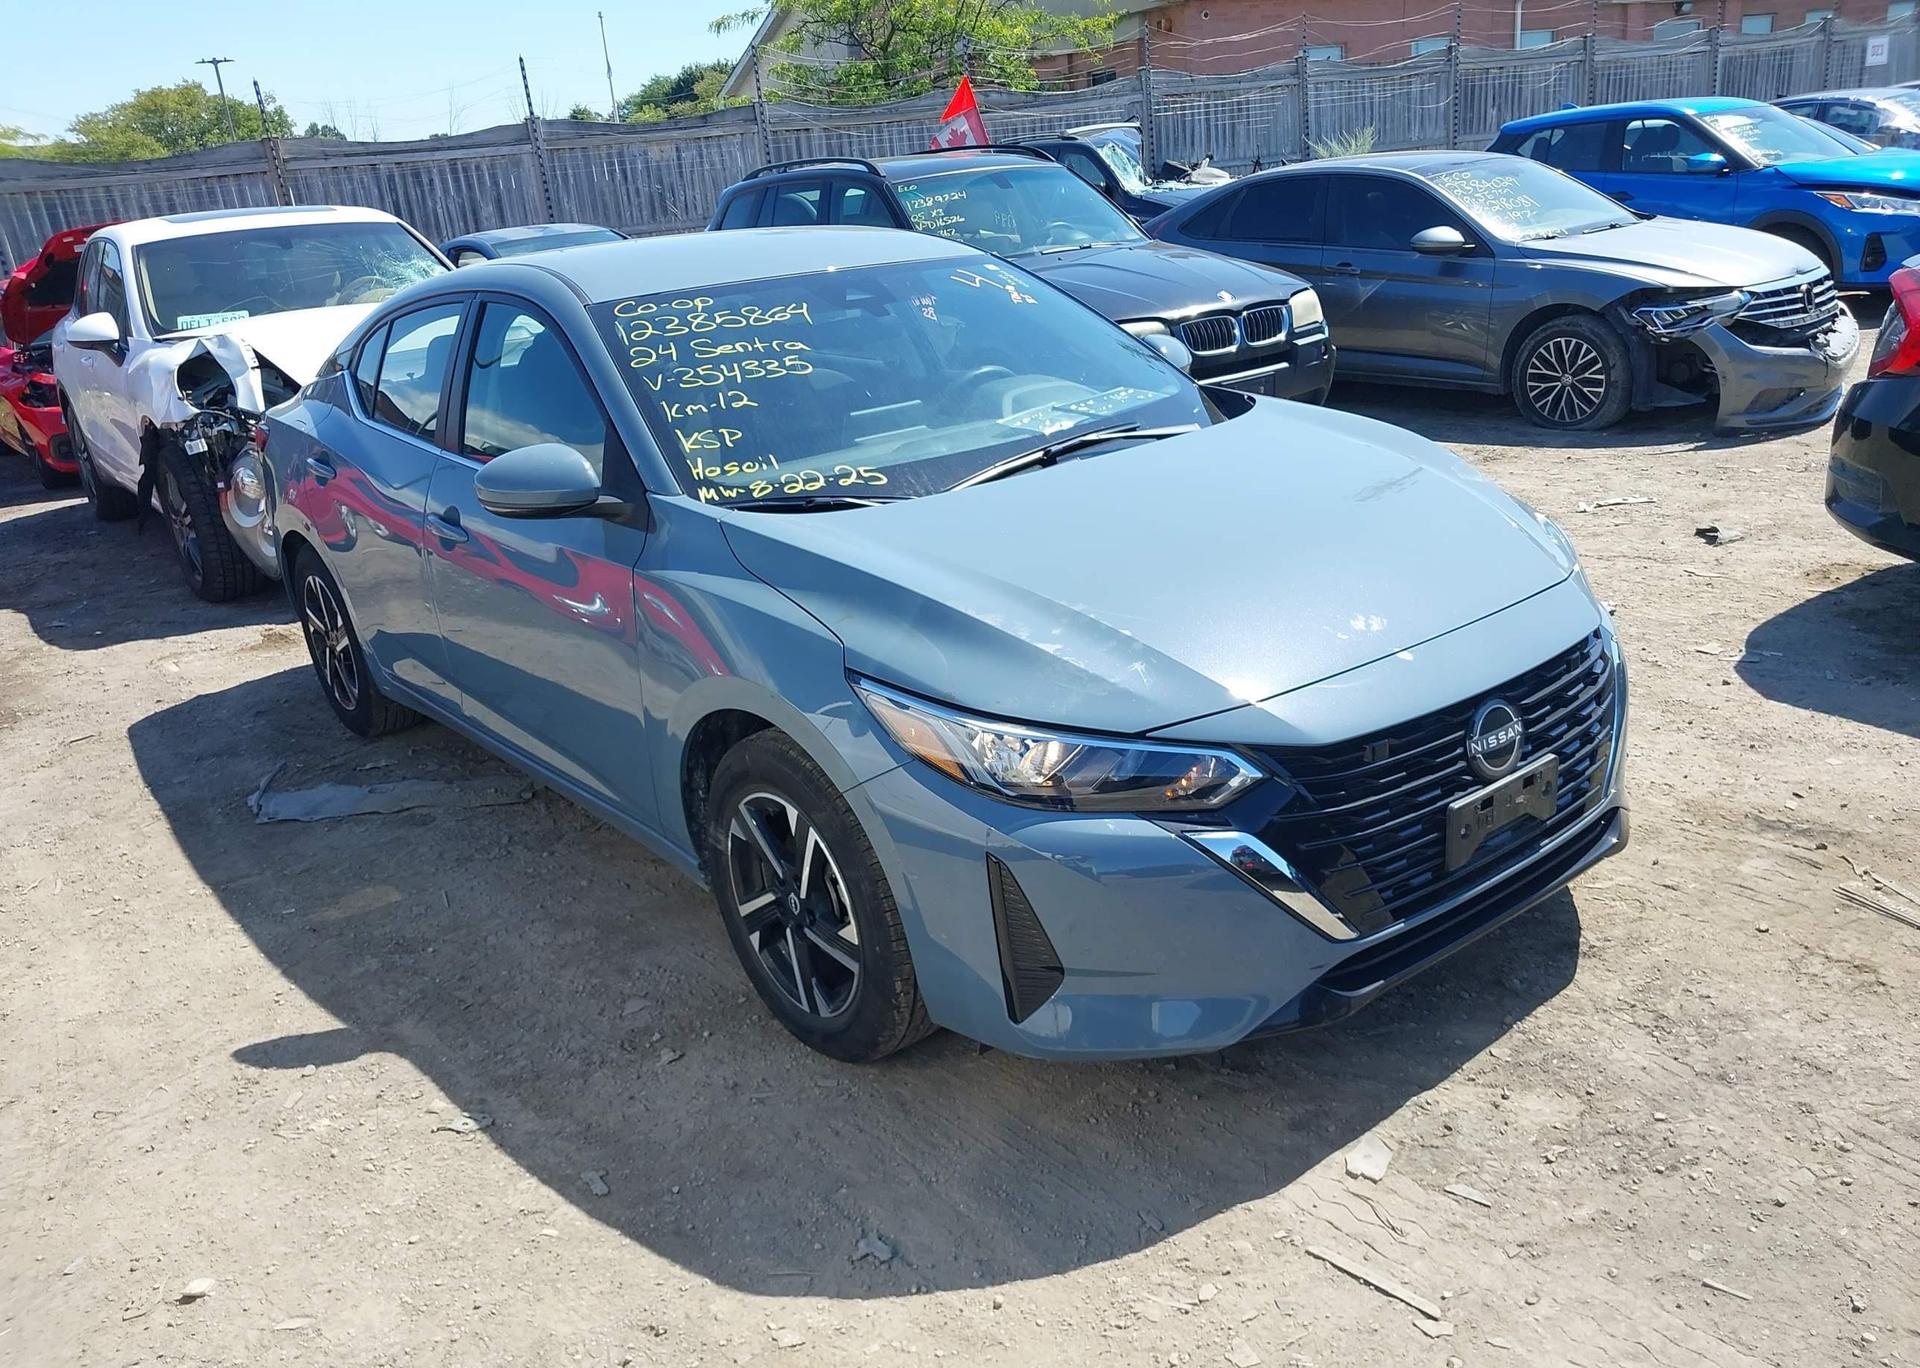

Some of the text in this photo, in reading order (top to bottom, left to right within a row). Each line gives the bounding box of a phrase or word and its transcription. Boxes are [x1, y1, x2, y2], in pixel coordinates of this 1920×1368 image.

[614, 302, 814, 346] 12385864
[629, 336, 812, 369] 24 Sentra
[674, 428, 743, 454] KSP
[1470, 721, 1523, 755] NISSAN
